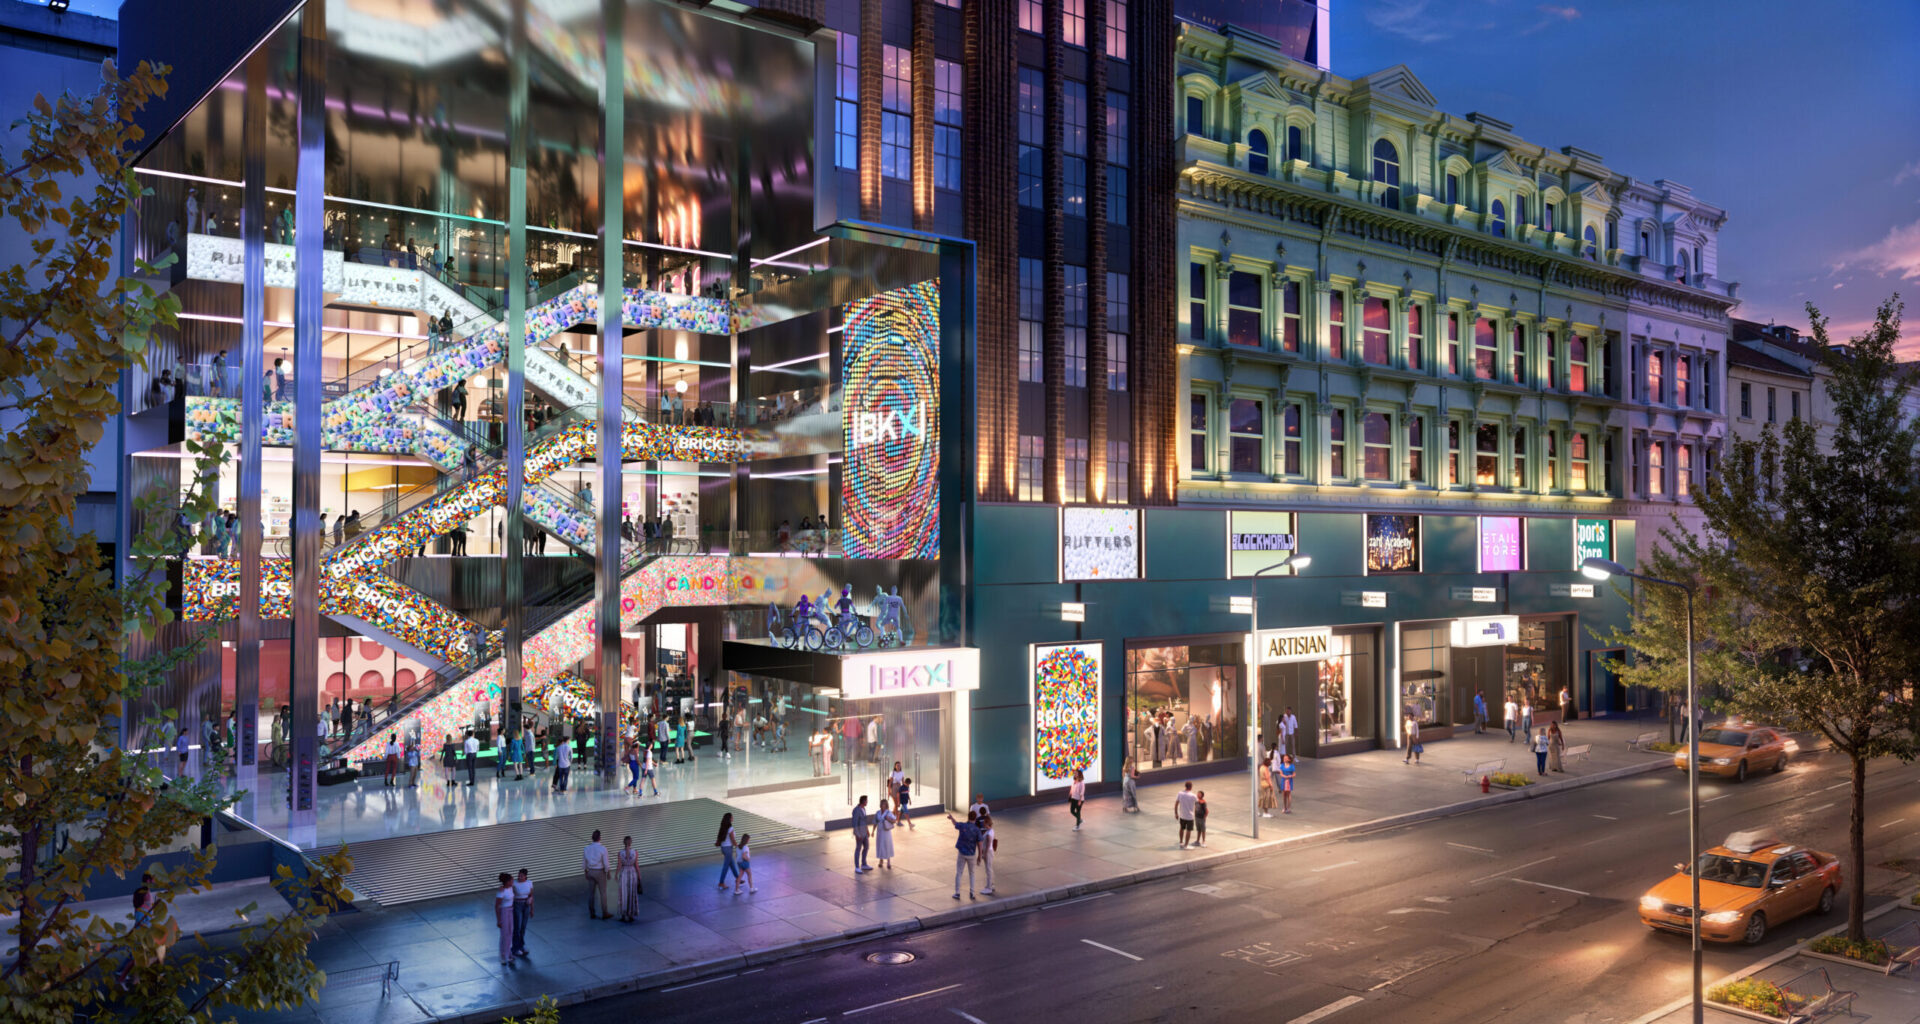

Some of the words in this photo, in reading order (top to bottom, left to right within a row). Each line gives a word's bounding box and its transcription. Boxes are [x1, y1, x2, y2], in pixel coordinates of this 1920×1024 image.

[527, 437, 582, 473] BRICKS
[679, 436, 731, 452] BRICKS
[433, 483, 495, 523] BRICKS
[331, 537, 399, 580] BRICKS
[666, 576, 726, 591] CANDY
[353, 582, 420, 628] BRICKS
[1268, 634, 1328, 658] ARTISIAN
